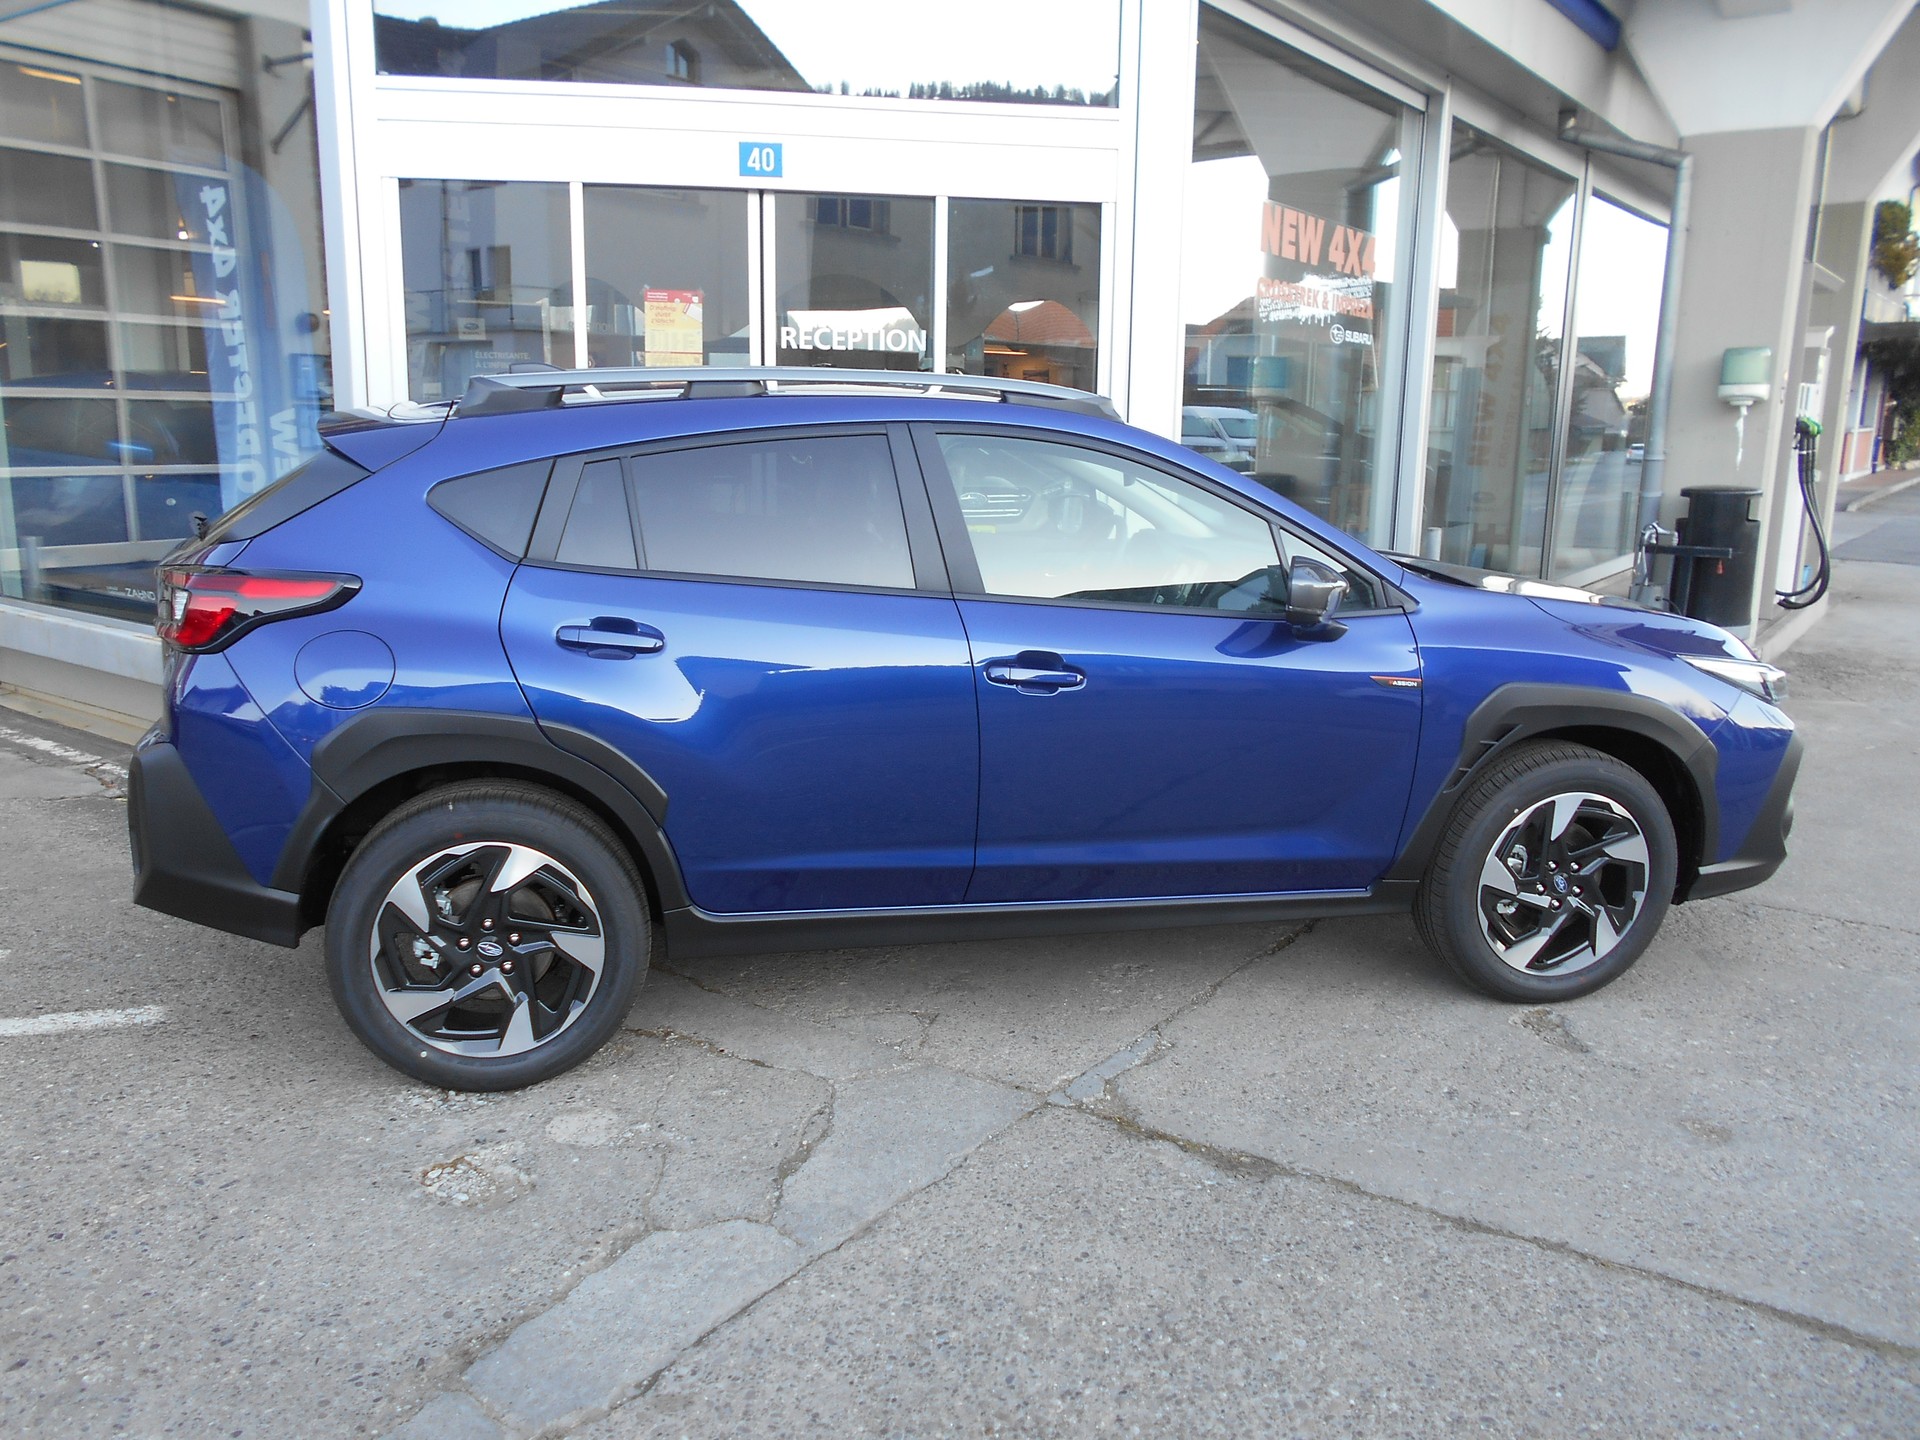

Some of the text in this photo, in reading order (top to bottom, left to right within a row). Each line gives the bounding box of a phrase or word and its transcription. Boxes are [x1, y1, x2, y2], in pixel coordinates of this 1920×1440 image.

[747, 147, 775, 172] 40
[1261, 201, 1376, 279] NEW 4X4
[1321, 289, 1329, 311] &
[781, 326, 927, 351] RECEPTION
[1345, 330, 1373, 345] SUBARU
